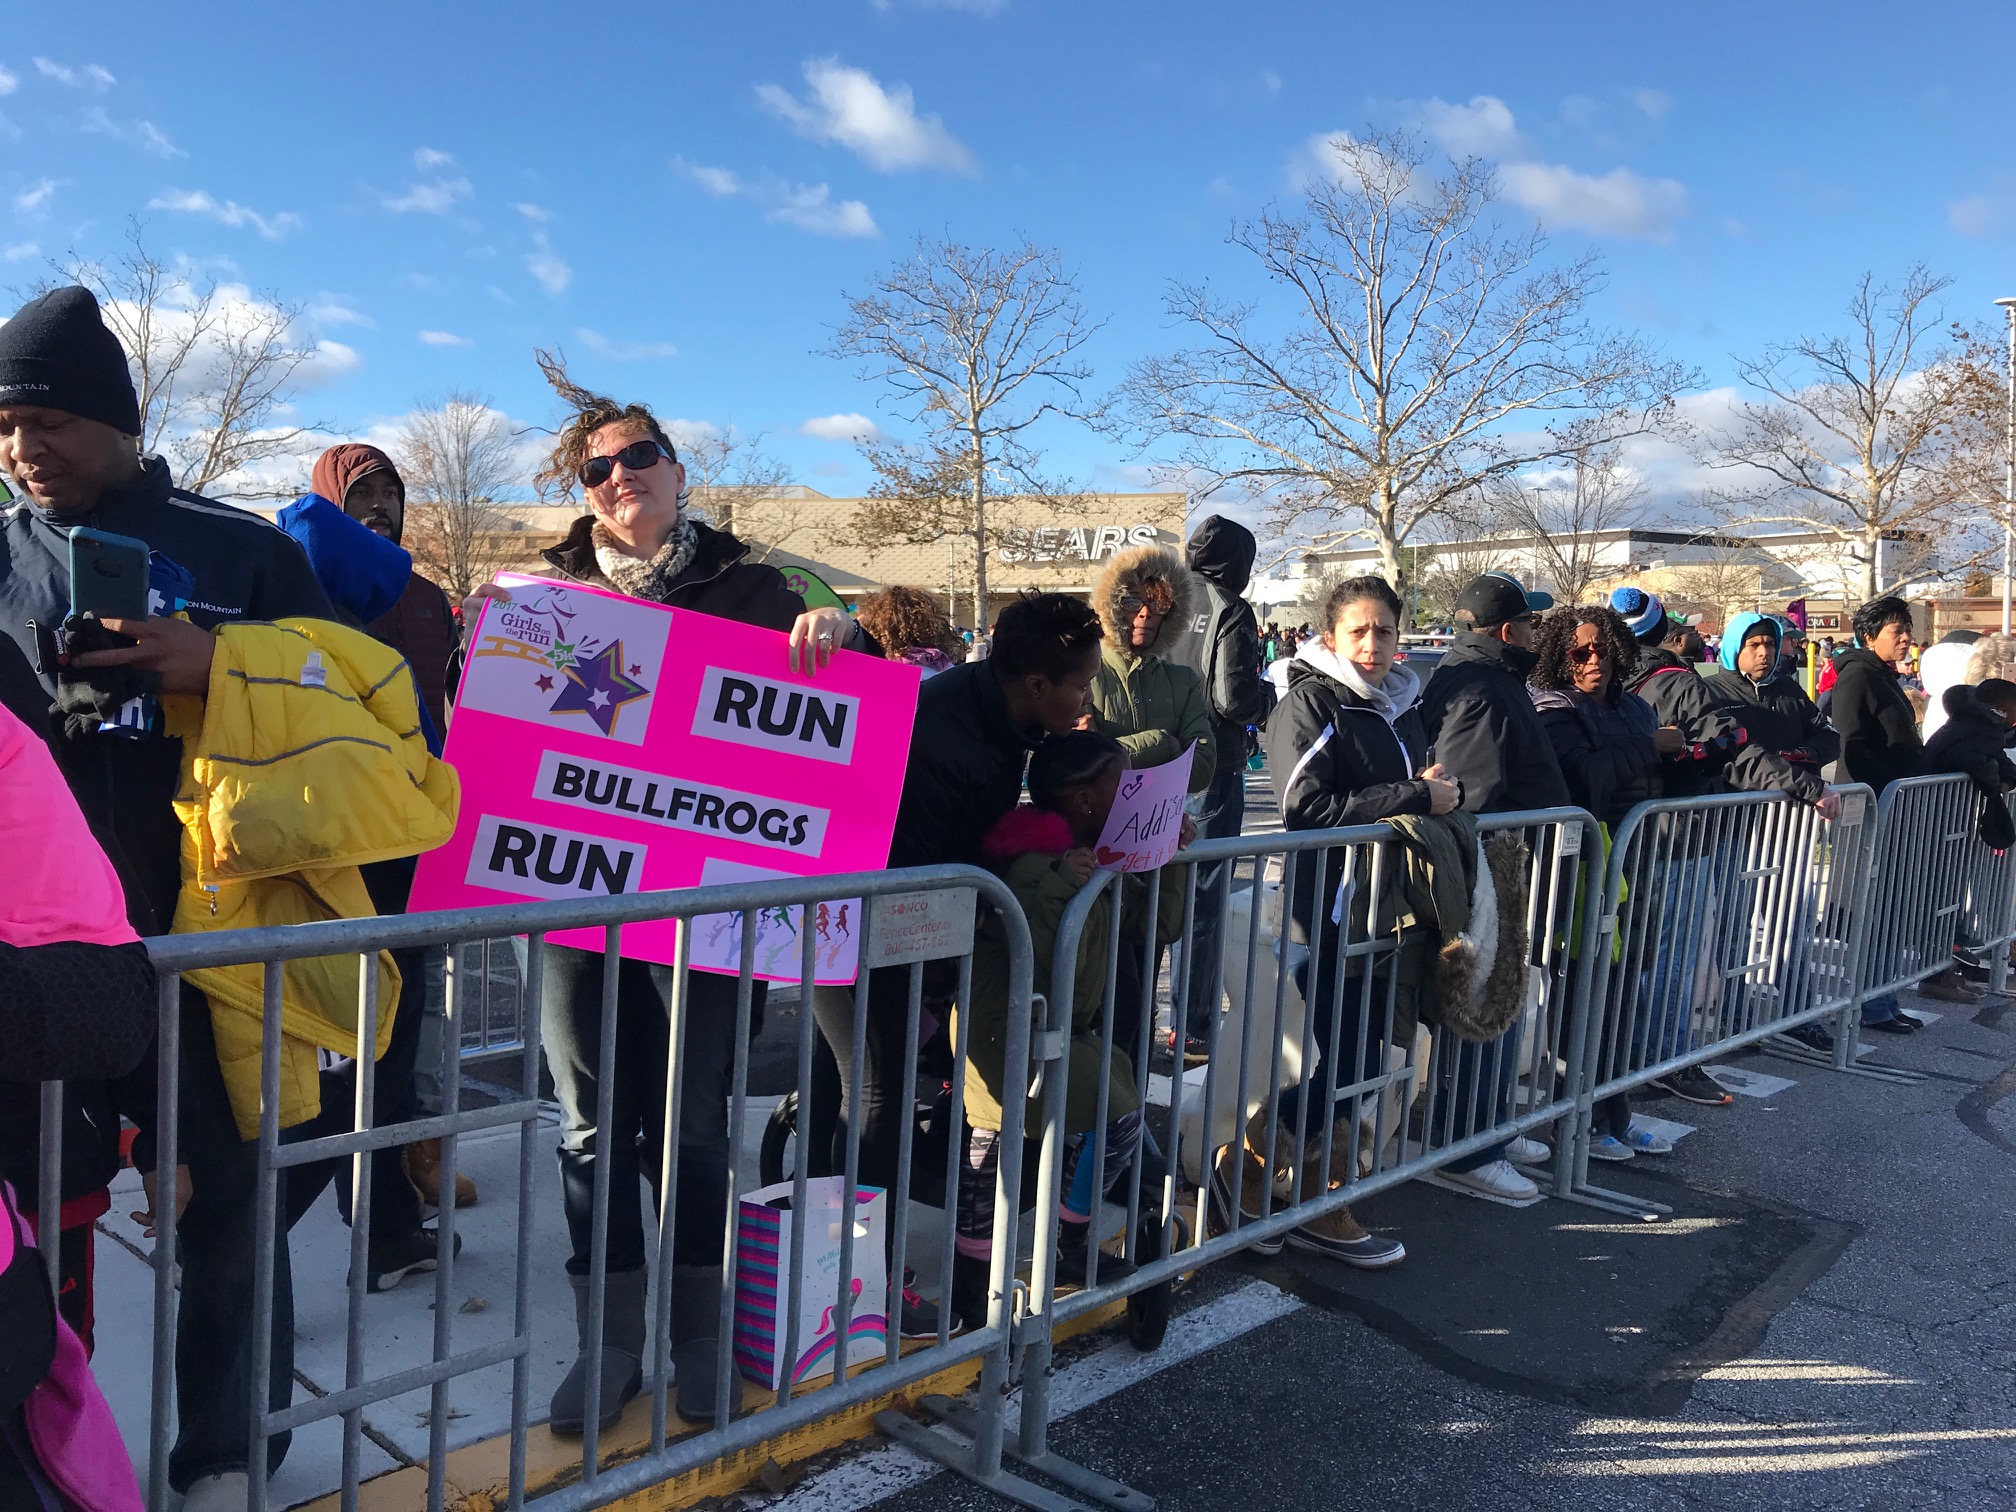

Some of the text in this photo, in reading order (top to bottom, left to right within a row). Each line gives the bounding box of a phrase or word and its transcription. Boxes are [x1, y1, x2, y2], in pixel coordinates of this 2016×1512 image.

[999, 524, 1158, 563] SEARS
[200, 602, 242, 614] MOUNTAIN
[492, 599, 518, 611] 2017
[500, 613, 551, 636] Girls on
[505, 627, 551, 646] the run
[713, 677, 848, 748] RUN
[552, 763, 808, 846] BULLFROGS
[488, 825, 633, 894] RUN
[1121, 850, 1151, 872] get
[1154, 847, 1164, 865] it
[891, 900, 928, 915] SONCO
